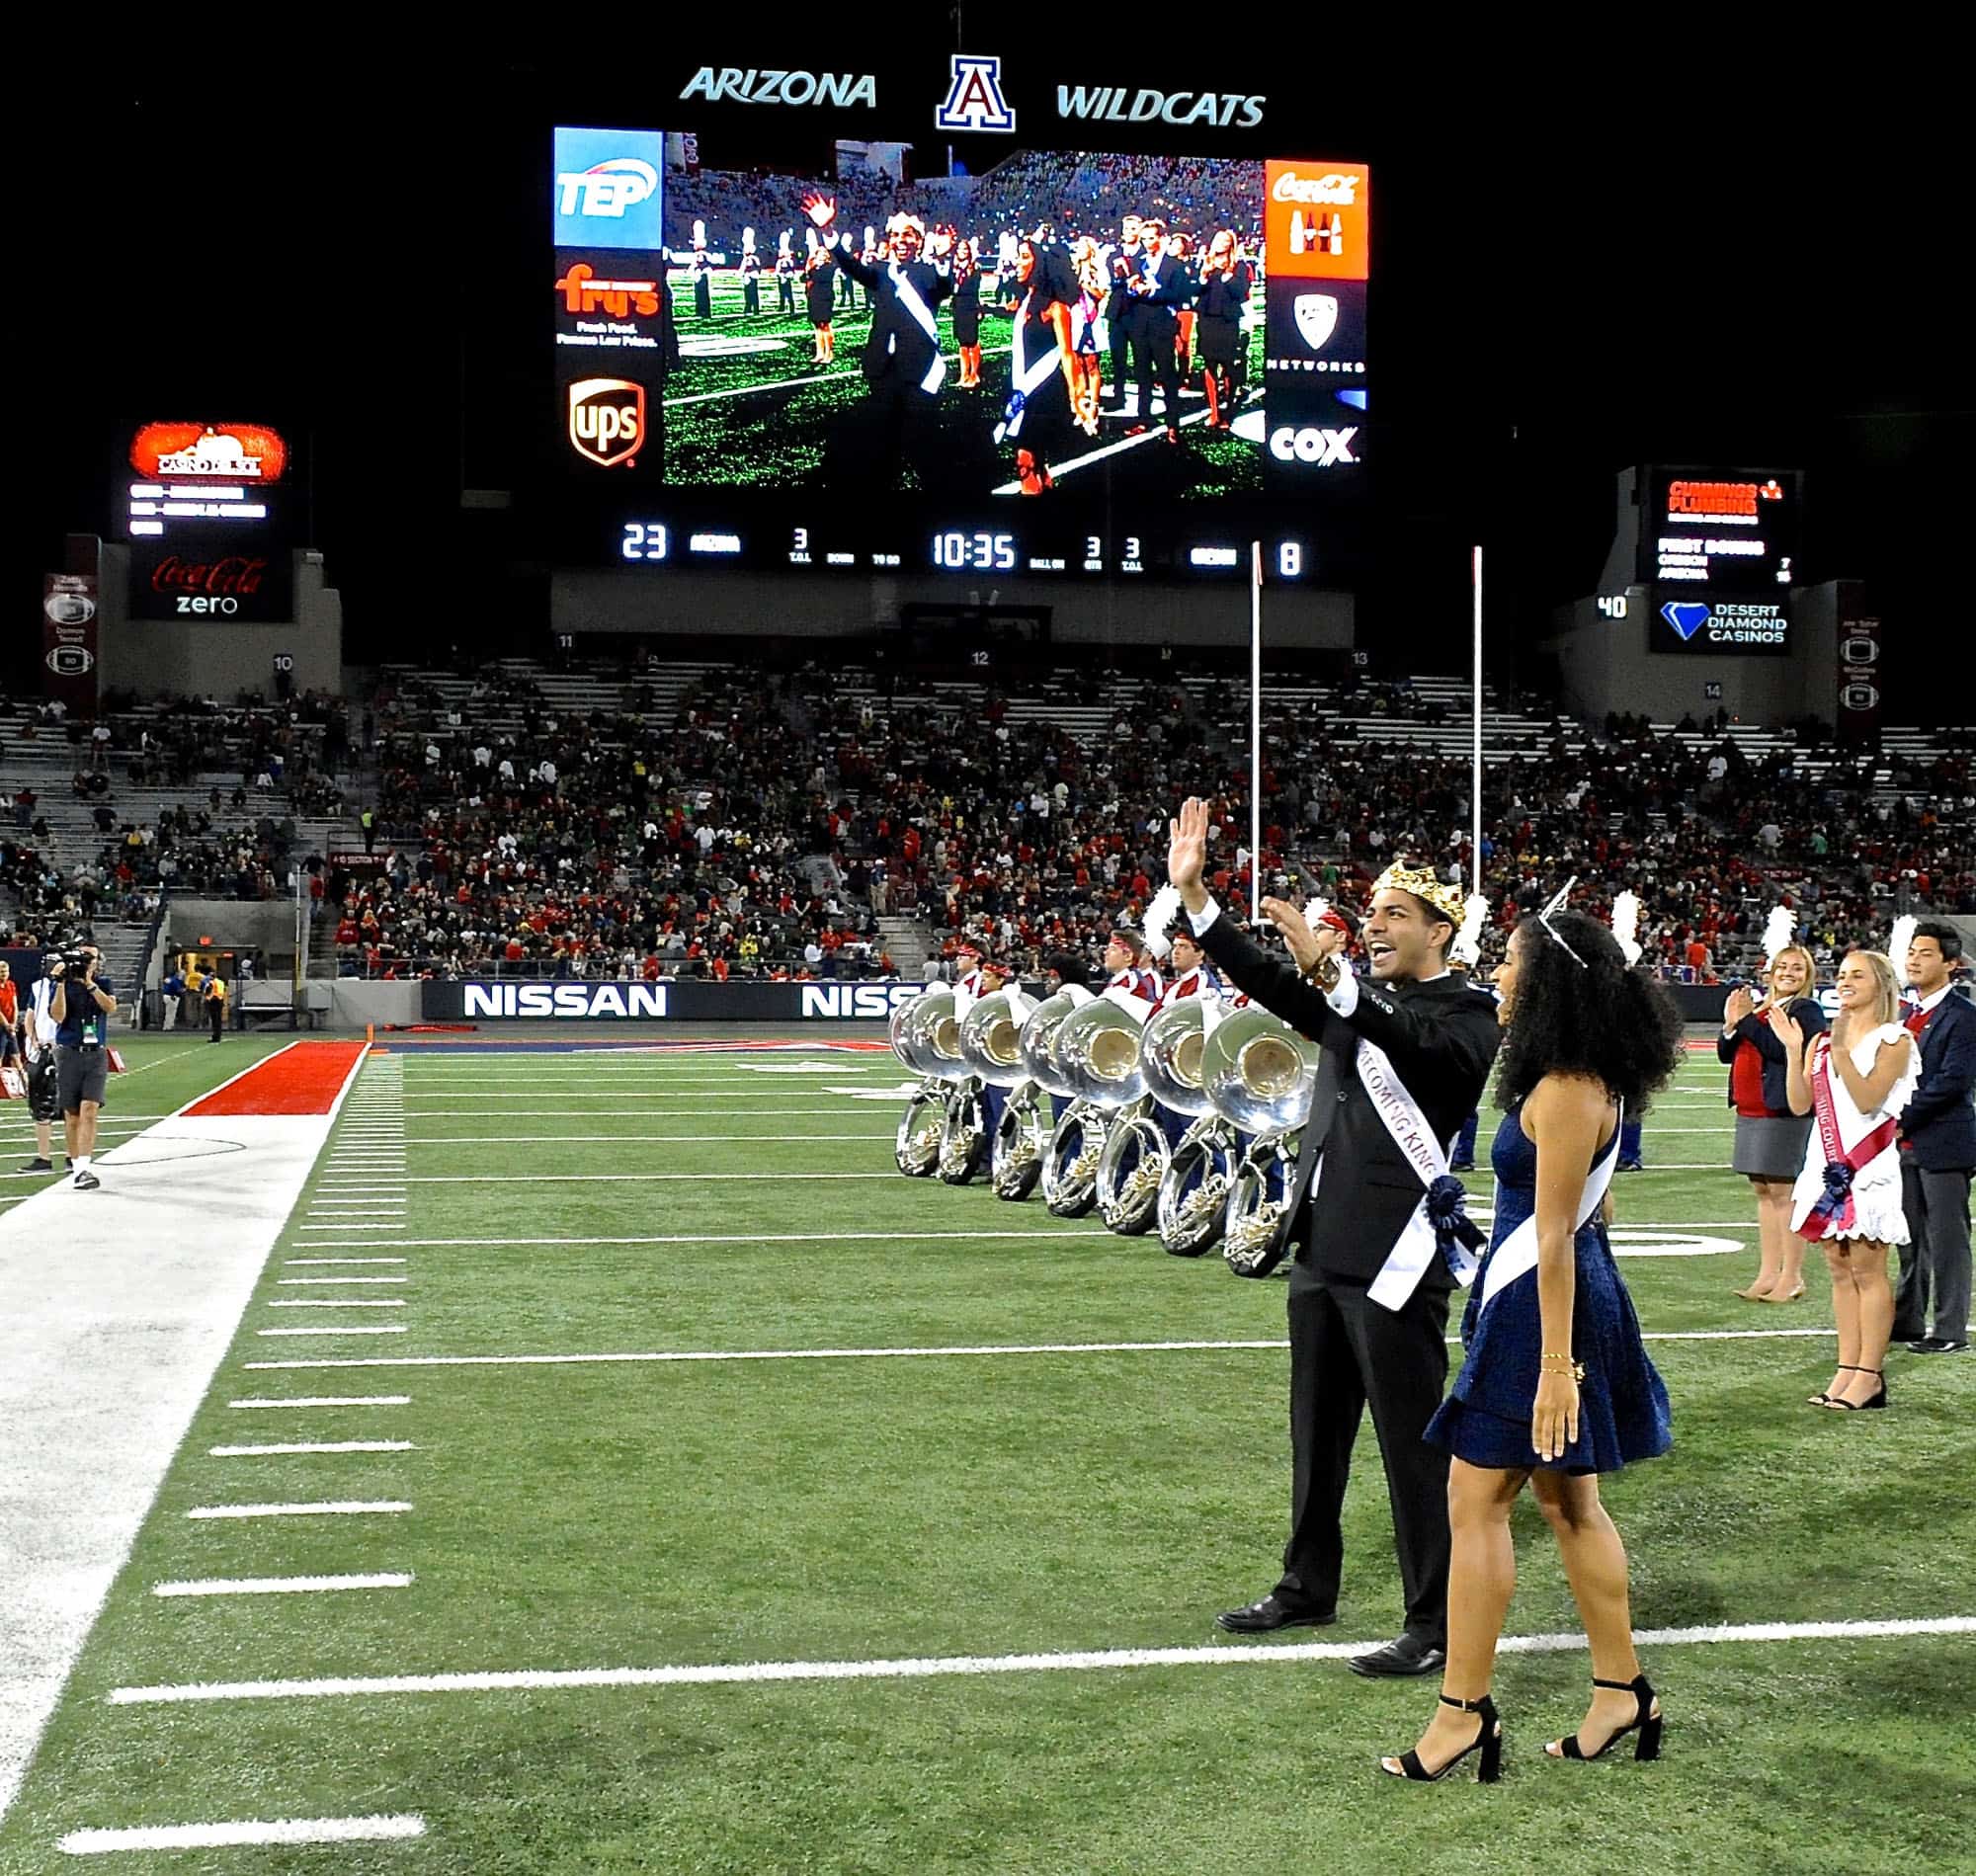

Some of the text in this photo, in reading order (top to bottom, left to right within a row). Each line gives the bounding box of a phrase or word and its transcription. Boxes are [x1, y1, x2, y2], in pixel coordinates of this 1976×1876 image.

[679, 67, 876, 108] ARIZONA
[936, 54, 1016, 132] A
[1057, 85, 1266, 126] WILDCATS
[557, 171, 647, 217] TEP
[1267, 359, 1365, 373] NETWORKS
[576, 405, 637, 451] ups
[1270, 426, 1358, 467] COX
[1669, 496, 1758, 515] PLUMBING
[622, 524, 666, 559] 23
[794, 528, 808, 549] 3
[1088, 536, 1101, 557] 3
[1126, 537, 1140, 559] 3
[934, 533, 1015, 568] 10:35
[1280, 542, 1300, 576] 8
[176, 596, 238, 614] zero
[1598, 596, 1627, 618] 40
[1715, 604, 1780, 617] DESERT
[1707, 616, 1787, 630] DIAMOND
[558, 634, 572, 648] 11
[1709, 629, 1784, 643] CASINOS
[274, 656, 293, 671] 10
[971, 651, 989, 665] 12
[1352, 652, 1368, 665] 13
[1706, 685, 1720, 696] 14
[463, 985, 667, 1018] NISSAN
